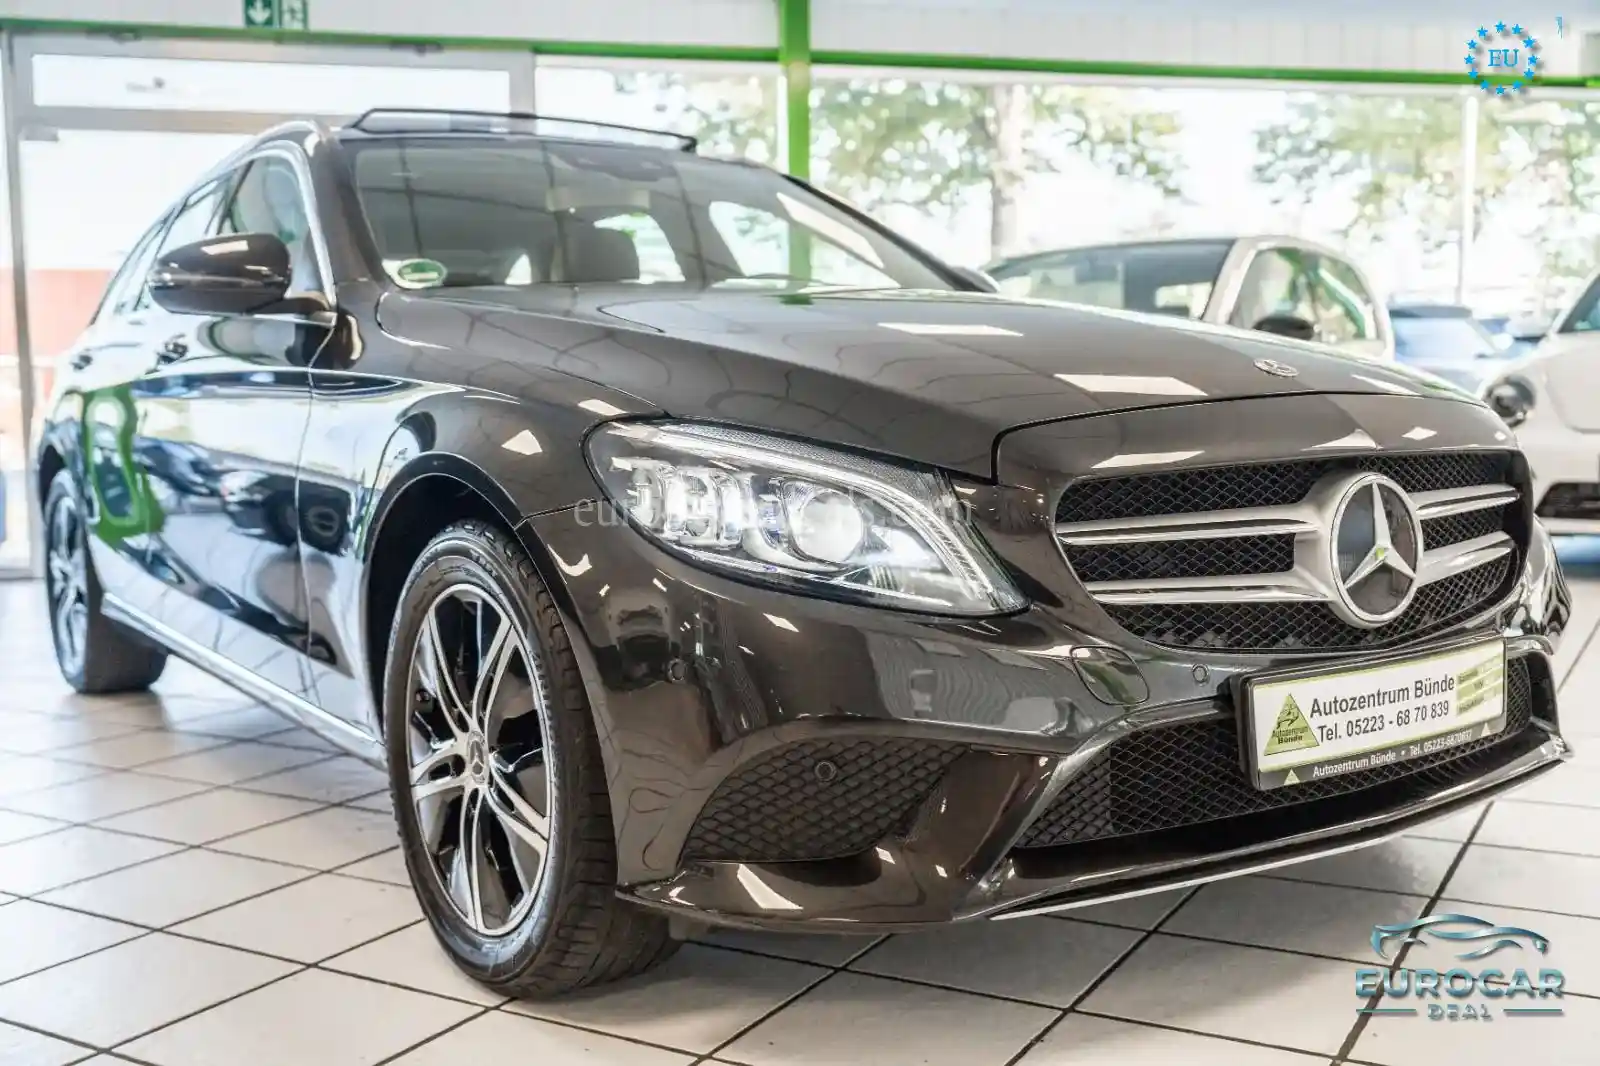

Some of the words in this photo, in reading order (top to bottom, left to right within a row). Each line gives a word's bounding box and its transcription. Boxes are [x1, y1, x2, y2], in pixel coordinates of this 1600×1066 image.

[1310, 684, 1410, 718] Autozentrum
[1414, 674, 1455, 698] Bünde
[1318, 724, 1342, 743] Tel.
[1347, 714, 1385, 736] 05223
[1396, 708, 1411, 727] 68
[1414, 704, 1428, 723] 70
[1431, 700, 1449, 719] 839
[1313, 758, 1370, 778] Autozentrum
[1371, 751, 1396, 768] Bünde
